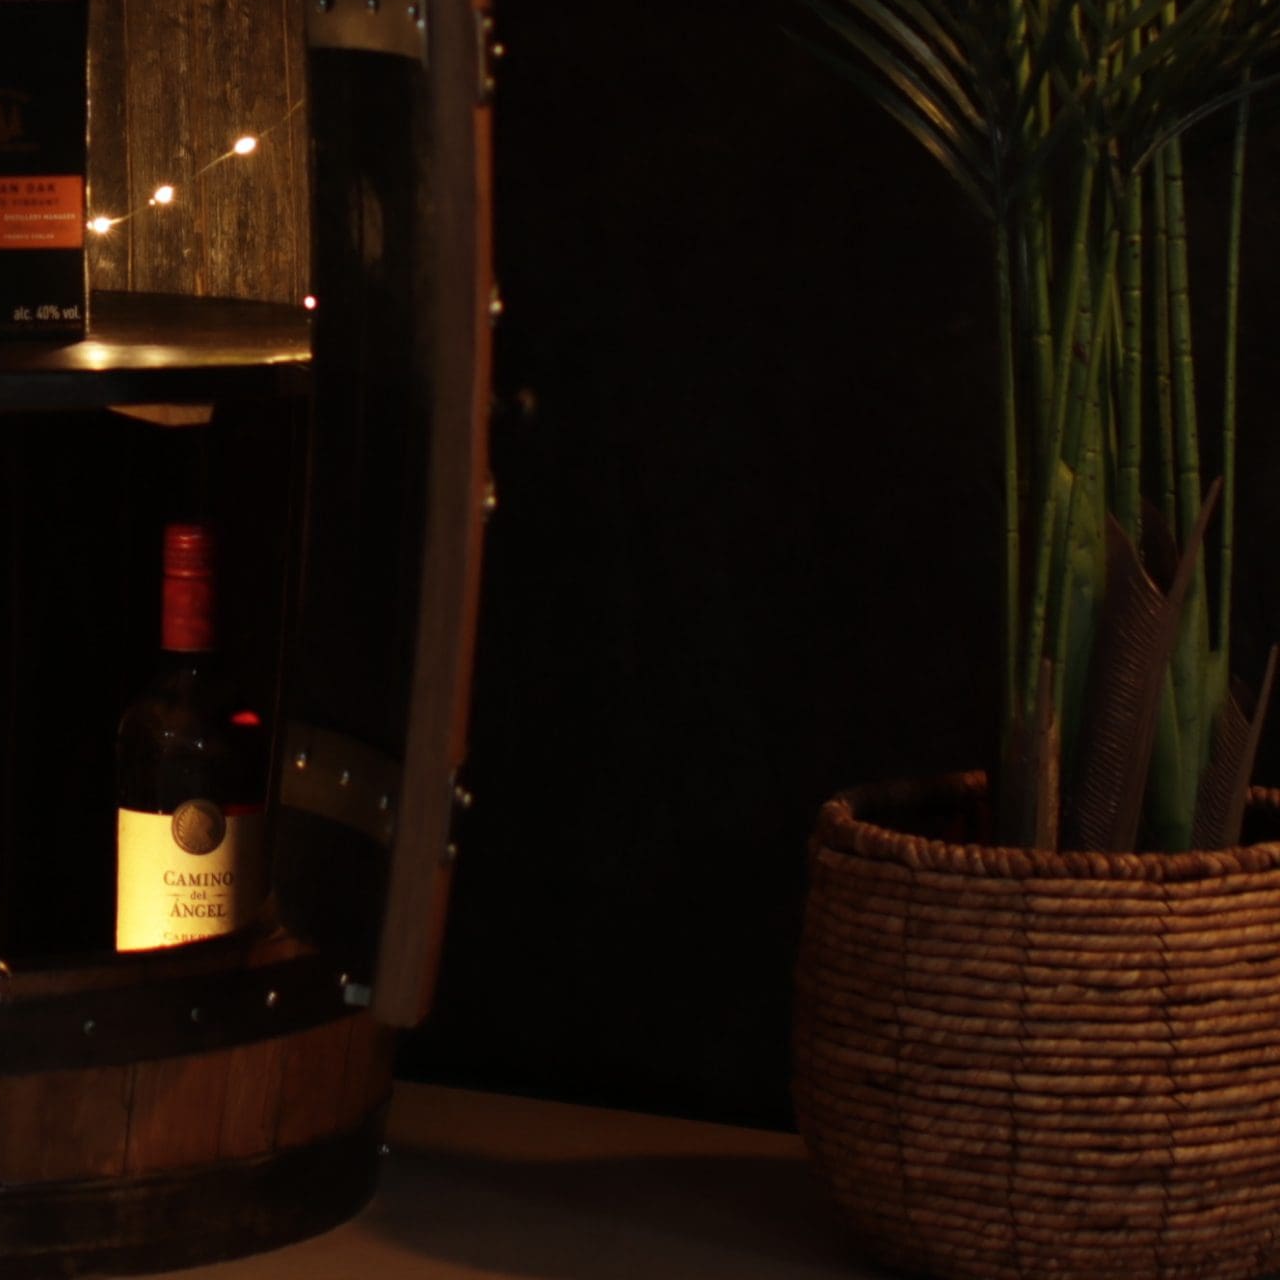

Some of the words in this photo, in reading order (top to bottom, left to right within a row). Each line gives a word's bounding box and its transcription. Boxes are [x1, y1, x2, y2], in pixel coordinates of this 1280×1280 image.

[36, 304, 60, 319] 40%
[163, 870, 233, 887] CAMINO
[190, 889, 207, 900] del
[170, 897, 226, 918] ÁNGEL
